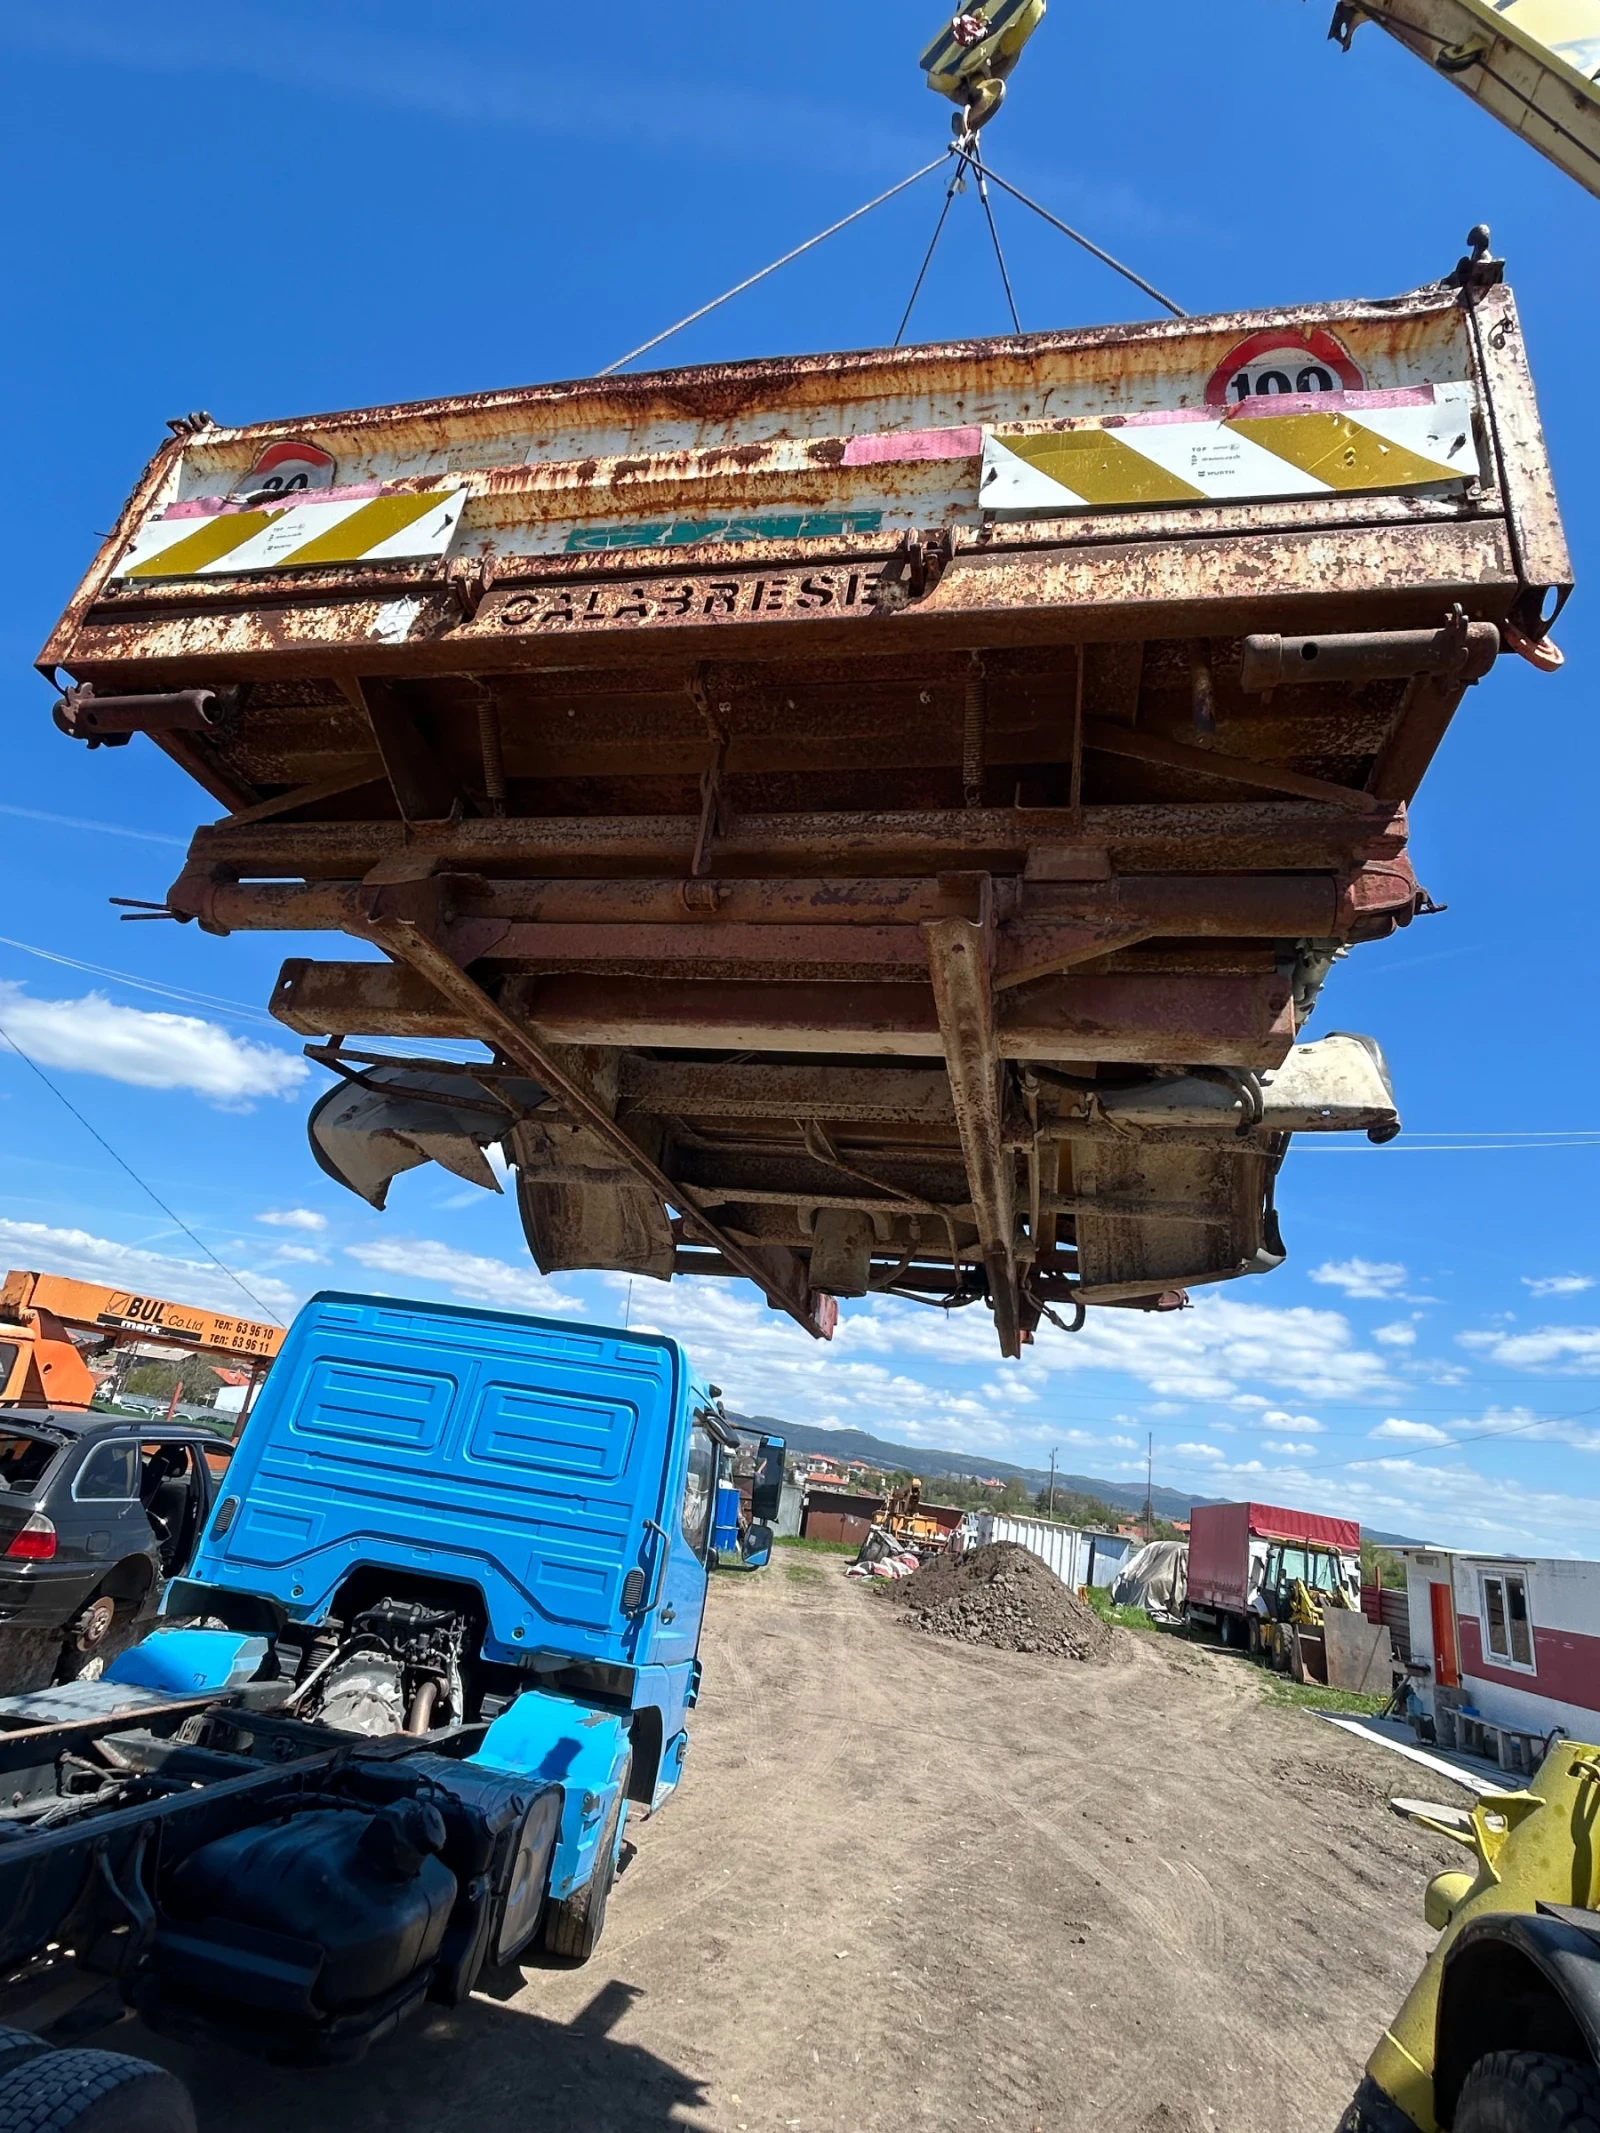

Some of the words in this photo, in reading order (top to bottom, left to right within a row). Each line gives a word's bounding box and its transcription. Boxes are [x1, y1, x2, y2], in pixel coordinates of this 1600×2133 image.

[500, 572, 882, 626] CALABRESE
[126, 1297, 167, 1324] BUL
[120, 1320, 162, 1334] mark
[236, 1321, 248, 1335] 63
[262, 1327, 274, 1340] 10
[231, 1336, 244, 1348] 63
[244, 1338, 258, 1351] 96
[259, 1341, 270, 1353] 11
